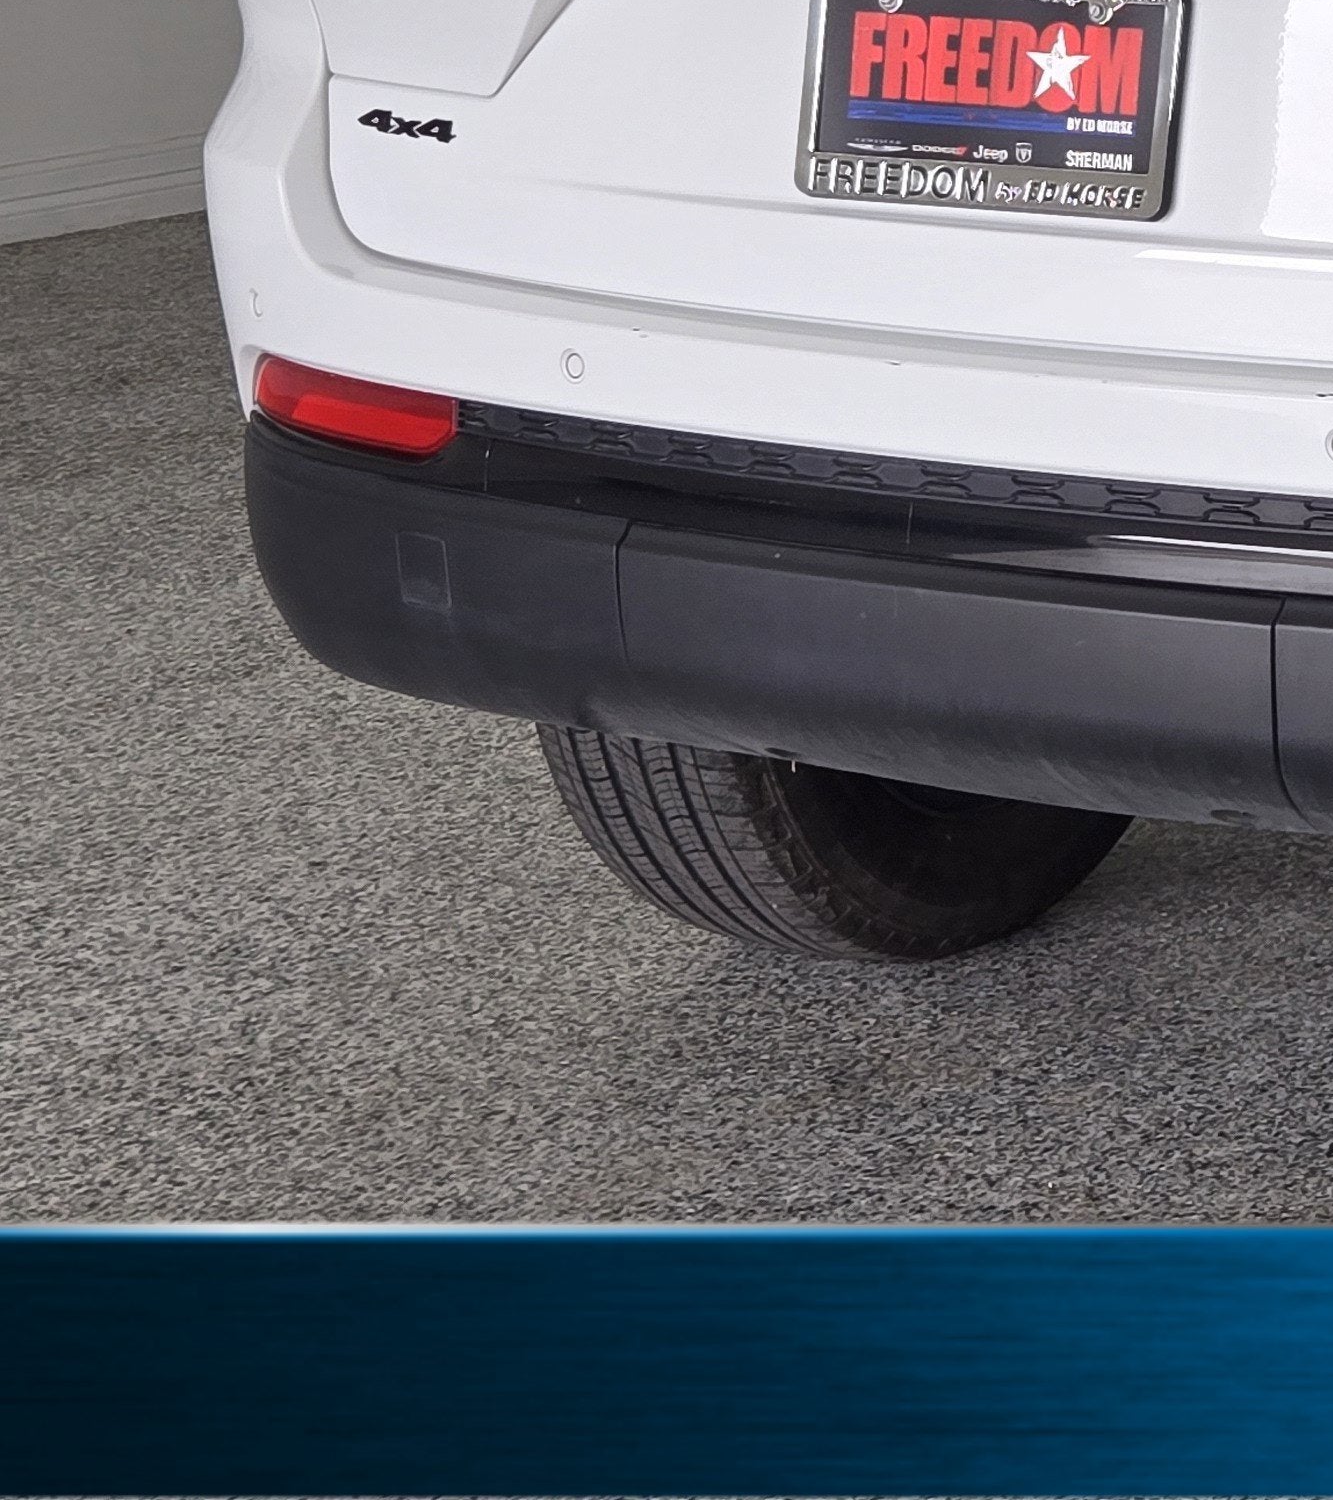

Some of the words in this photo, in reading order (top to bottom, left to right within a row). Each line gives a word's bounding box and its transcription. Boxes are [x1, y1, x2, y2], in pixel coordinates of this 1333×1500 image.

[850, 11, 1143, 116] FREEDOM
[357, 108, 457, 143] 4x4
[1066, 116, 1081, 131] BY
[1082, 118, 1095, 132] ED
[1096, 119, 1133, 135] MORSE
[973, 145, 1008, 162] Jeep
[1065, 150, 1133, 171] SHERMAN
[808, 157, 991, 203] FREEDOM
[1022, 180, 1060, 204] ED
[1060, 182, 1147, 209] MORSE
